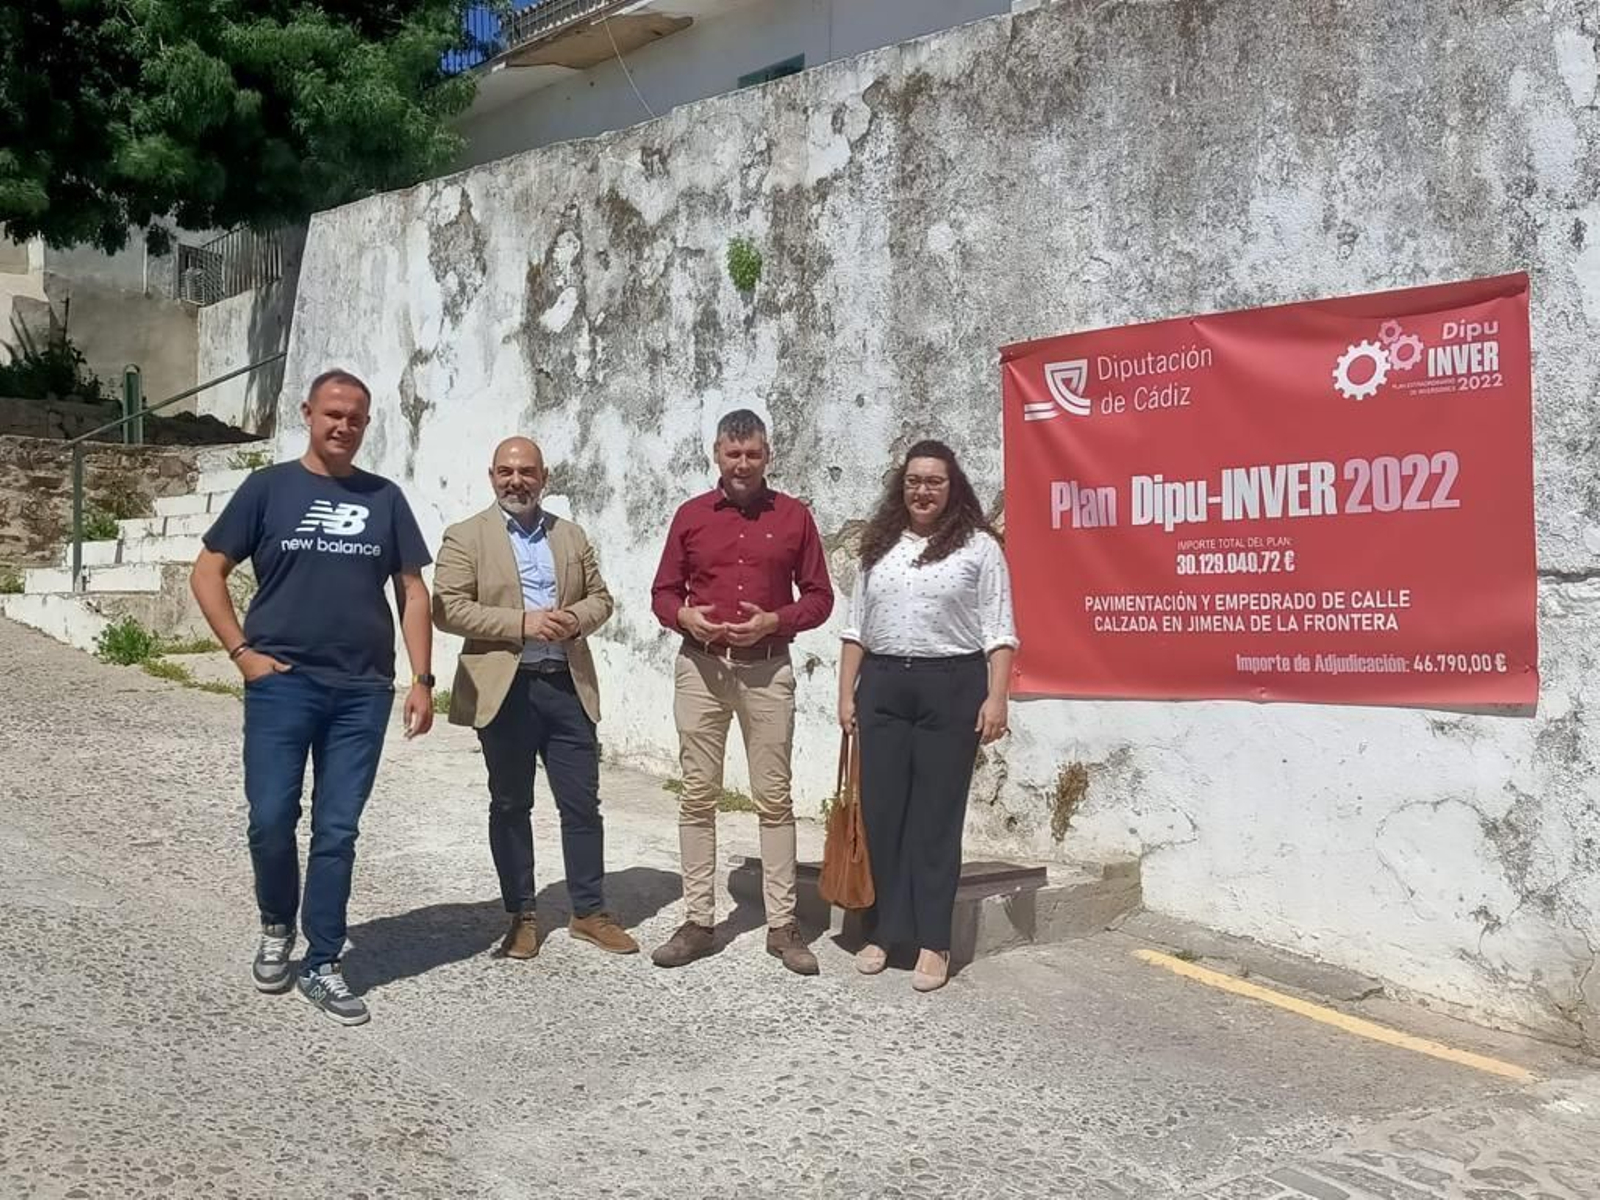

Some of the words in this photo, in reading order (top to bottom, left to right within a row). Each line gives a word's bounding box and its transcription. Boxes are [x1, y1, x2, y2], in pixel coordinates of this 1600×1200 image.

[1442, 319, 1498, 342] Dipu
[1097, 345, 1212, 382] Diputación
[1428, 341, 1499, 377] INVER
[1458, 374, 1503, 391] 2022
[1100, 391, 1126, 414] de
[1134, 385, 1192, 410] Cádiz
[1050, 480, 1118, 529] Plan
[1131, 461, 1338, 532] Dipu-INVER
[1343, 451, 1460, 514] 2022
[281, 538, 314, 551] new
[317, 537, 381, 556] balance
[1177, 539, 1216, 550] IMPORTE
[1219, 538, 1245, 549] TOTAL
[1247, 537, 1264, 547] DEL
[1176, 551, 1281, 575] 30.129.040,72
[1284, 550, 1295, 572] €
[1085, 591, 1197, 612] PAVIMENTACIÓN
[1200, 594, 1211, 611] Y
[1215, 592, 1316, 611] EMPEDRADO
[1322, 591, 1345, 609] DE
[1351, 589, 1410, 608] CALLE
[1094, 616, 1158, 632] CALZADA
[1162, 616, 1182, 632] EN
[1187, 615, 1245, 632] JIMENA
[1250, 615, 1272, 632] DE
[1277, 615, 1299, 632] LA
[1304, 613, 1398, 631] FRONTERA
[1236, 653, 1290, 675] Importe
[1293, 653, 1311, 673] de
[1315, 653, 1410, 676] Adjudicación:
[1413, 654, 1492, 675] 46.790,00
[1495, 652, 1507, 673] €
